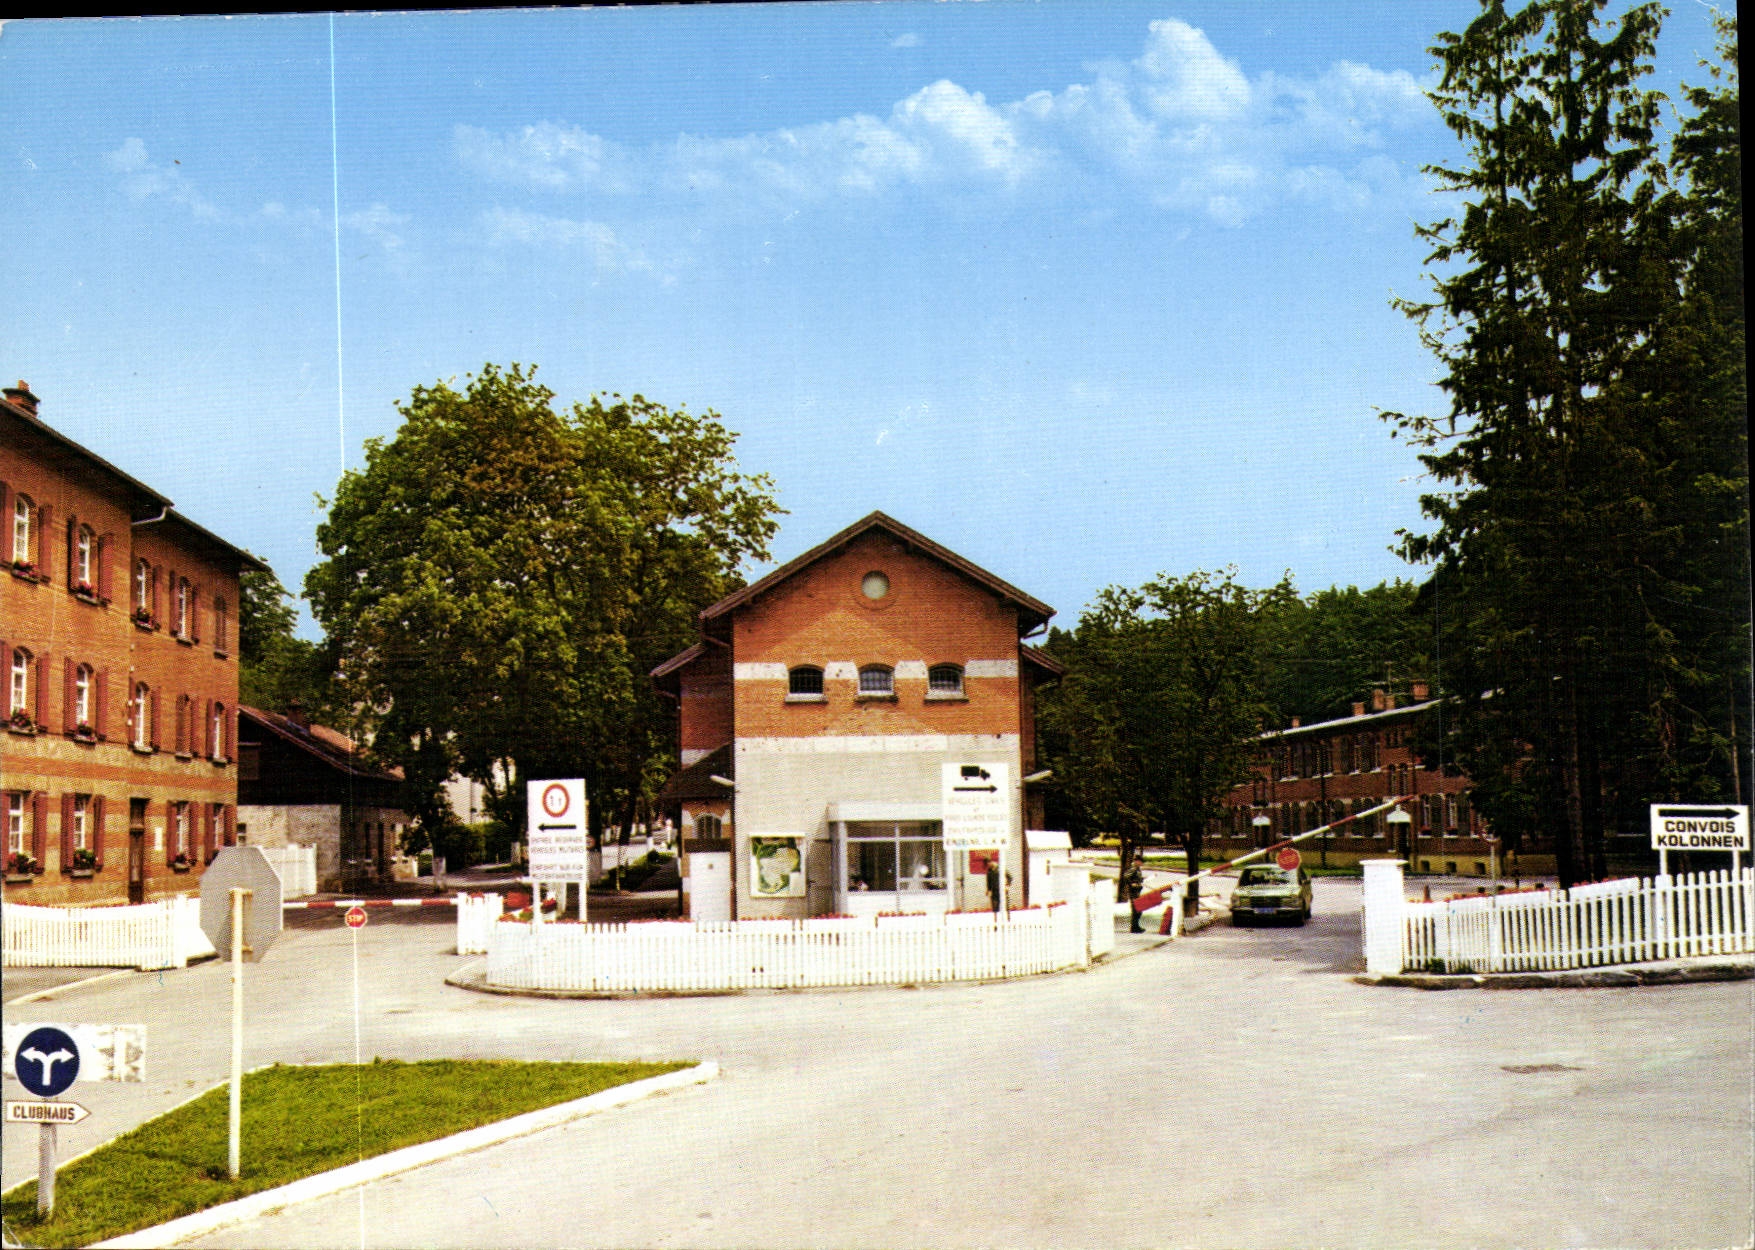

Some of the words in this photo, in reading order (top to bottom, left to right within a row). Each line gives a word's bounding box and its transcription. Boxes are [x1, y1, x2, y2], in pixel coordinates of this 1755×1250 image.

[1664, 820, 1735, 833] CONVOIS
[1657, 835, 1744, 847] KOLONNEN
[13, 1105, 75, 1120] CLUBHAUS
